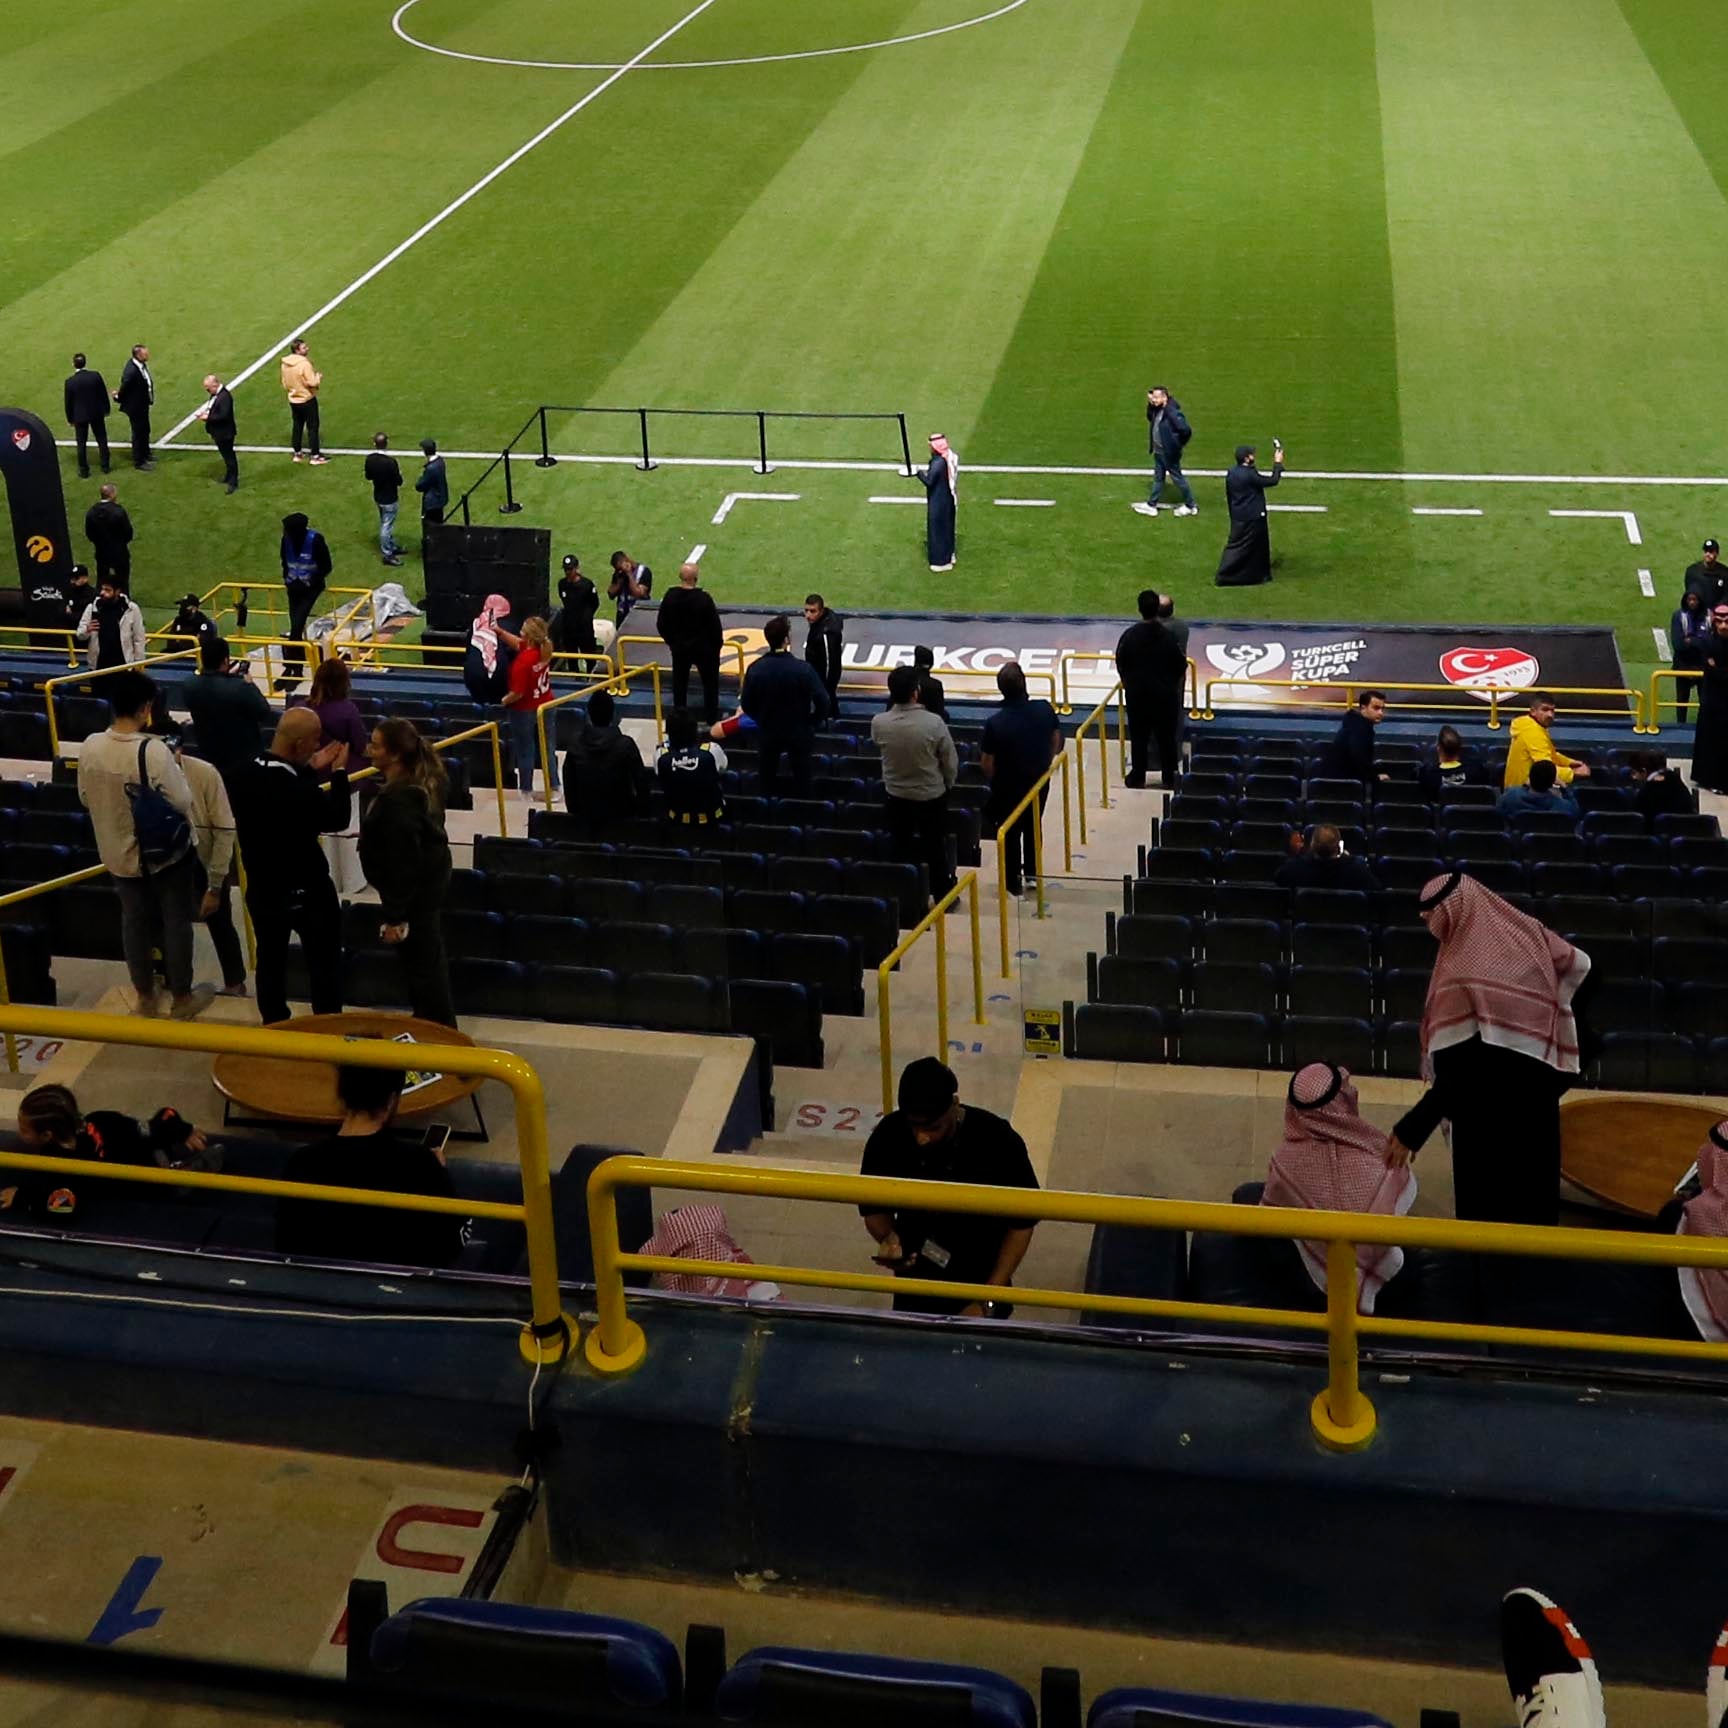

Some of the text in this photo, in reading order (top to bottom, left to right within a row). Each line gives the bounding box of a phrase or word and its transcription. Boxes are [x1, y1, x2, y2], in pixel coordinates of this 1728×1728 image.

[840, 641, 1119, 673] URKCELL
[1290, 639, 1368, 662] TURKCELL
[1290, 651, 1361, 672] SÜPER
[1290, 663, 1351, 683] KUPA
[795, 1103, 885, 1133] S2
